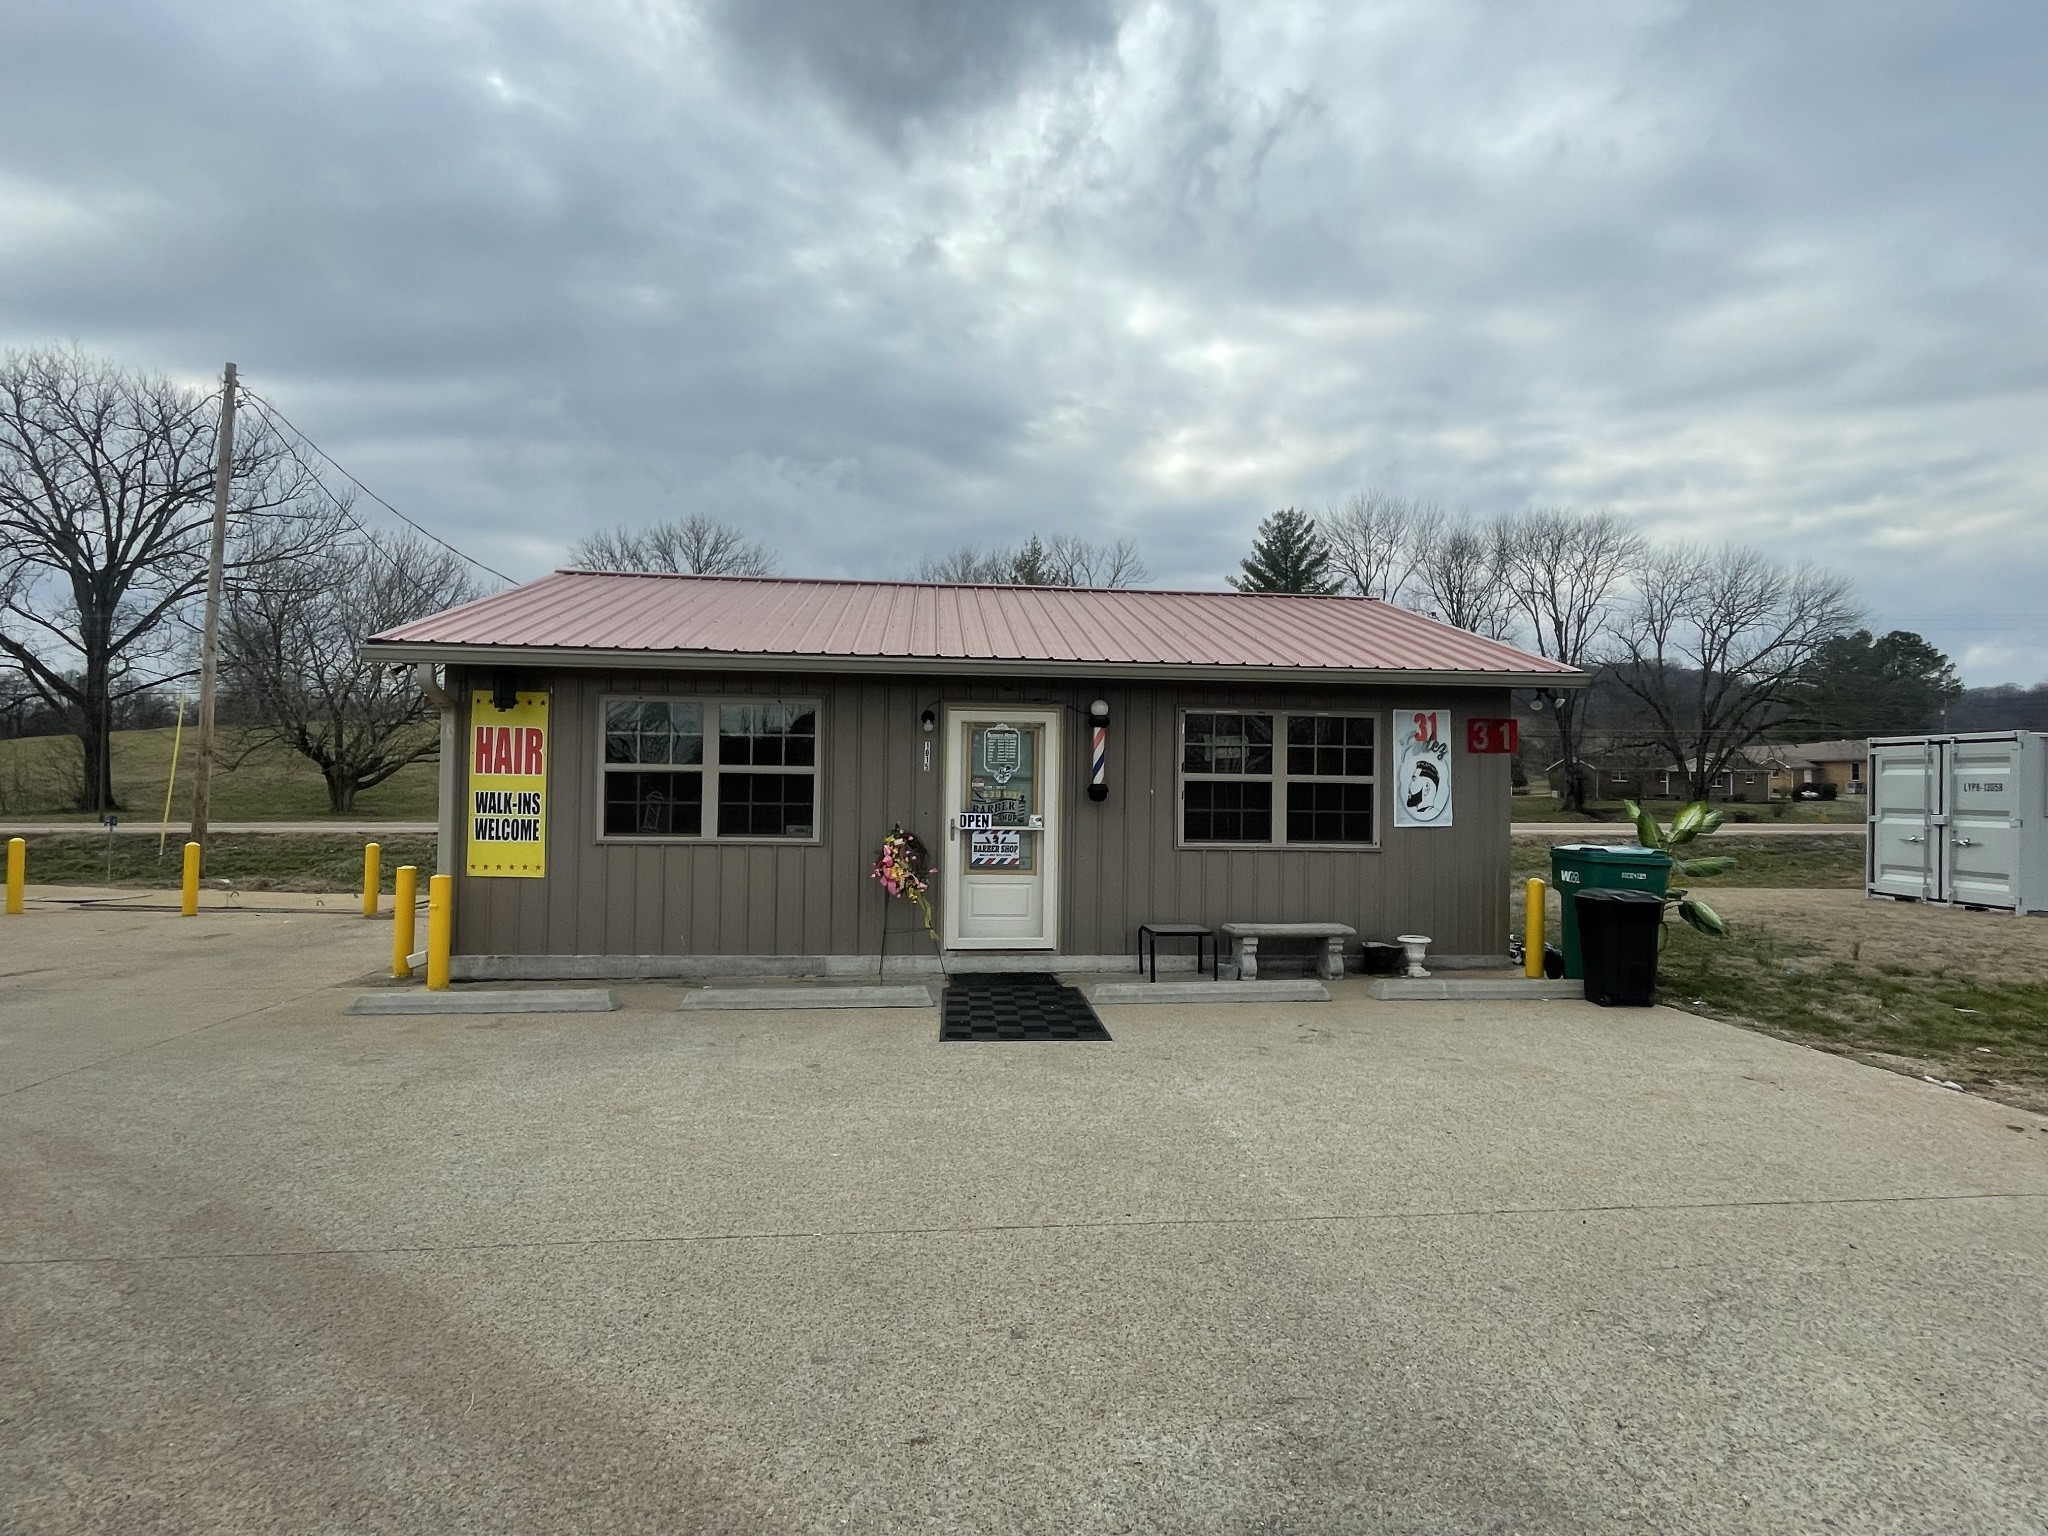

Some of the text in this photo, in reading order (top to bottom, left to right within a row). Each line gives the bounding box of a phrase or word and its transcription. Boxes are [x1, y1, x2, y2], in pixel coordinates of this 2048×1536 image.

[1413, 712, 1437, 742] 31
[1472, 721, 1510, 751] 31
[475, 727, 543, 775] HAIR
[475, 792, 541, 815] WALK-INS
[972, 801, 1015, 813] BARBER
[475, 818, 539, 841] WELCOME
[960, 814, 989, 828] OPEN
[973, 845, 1018, 853] BARBER SHOP
